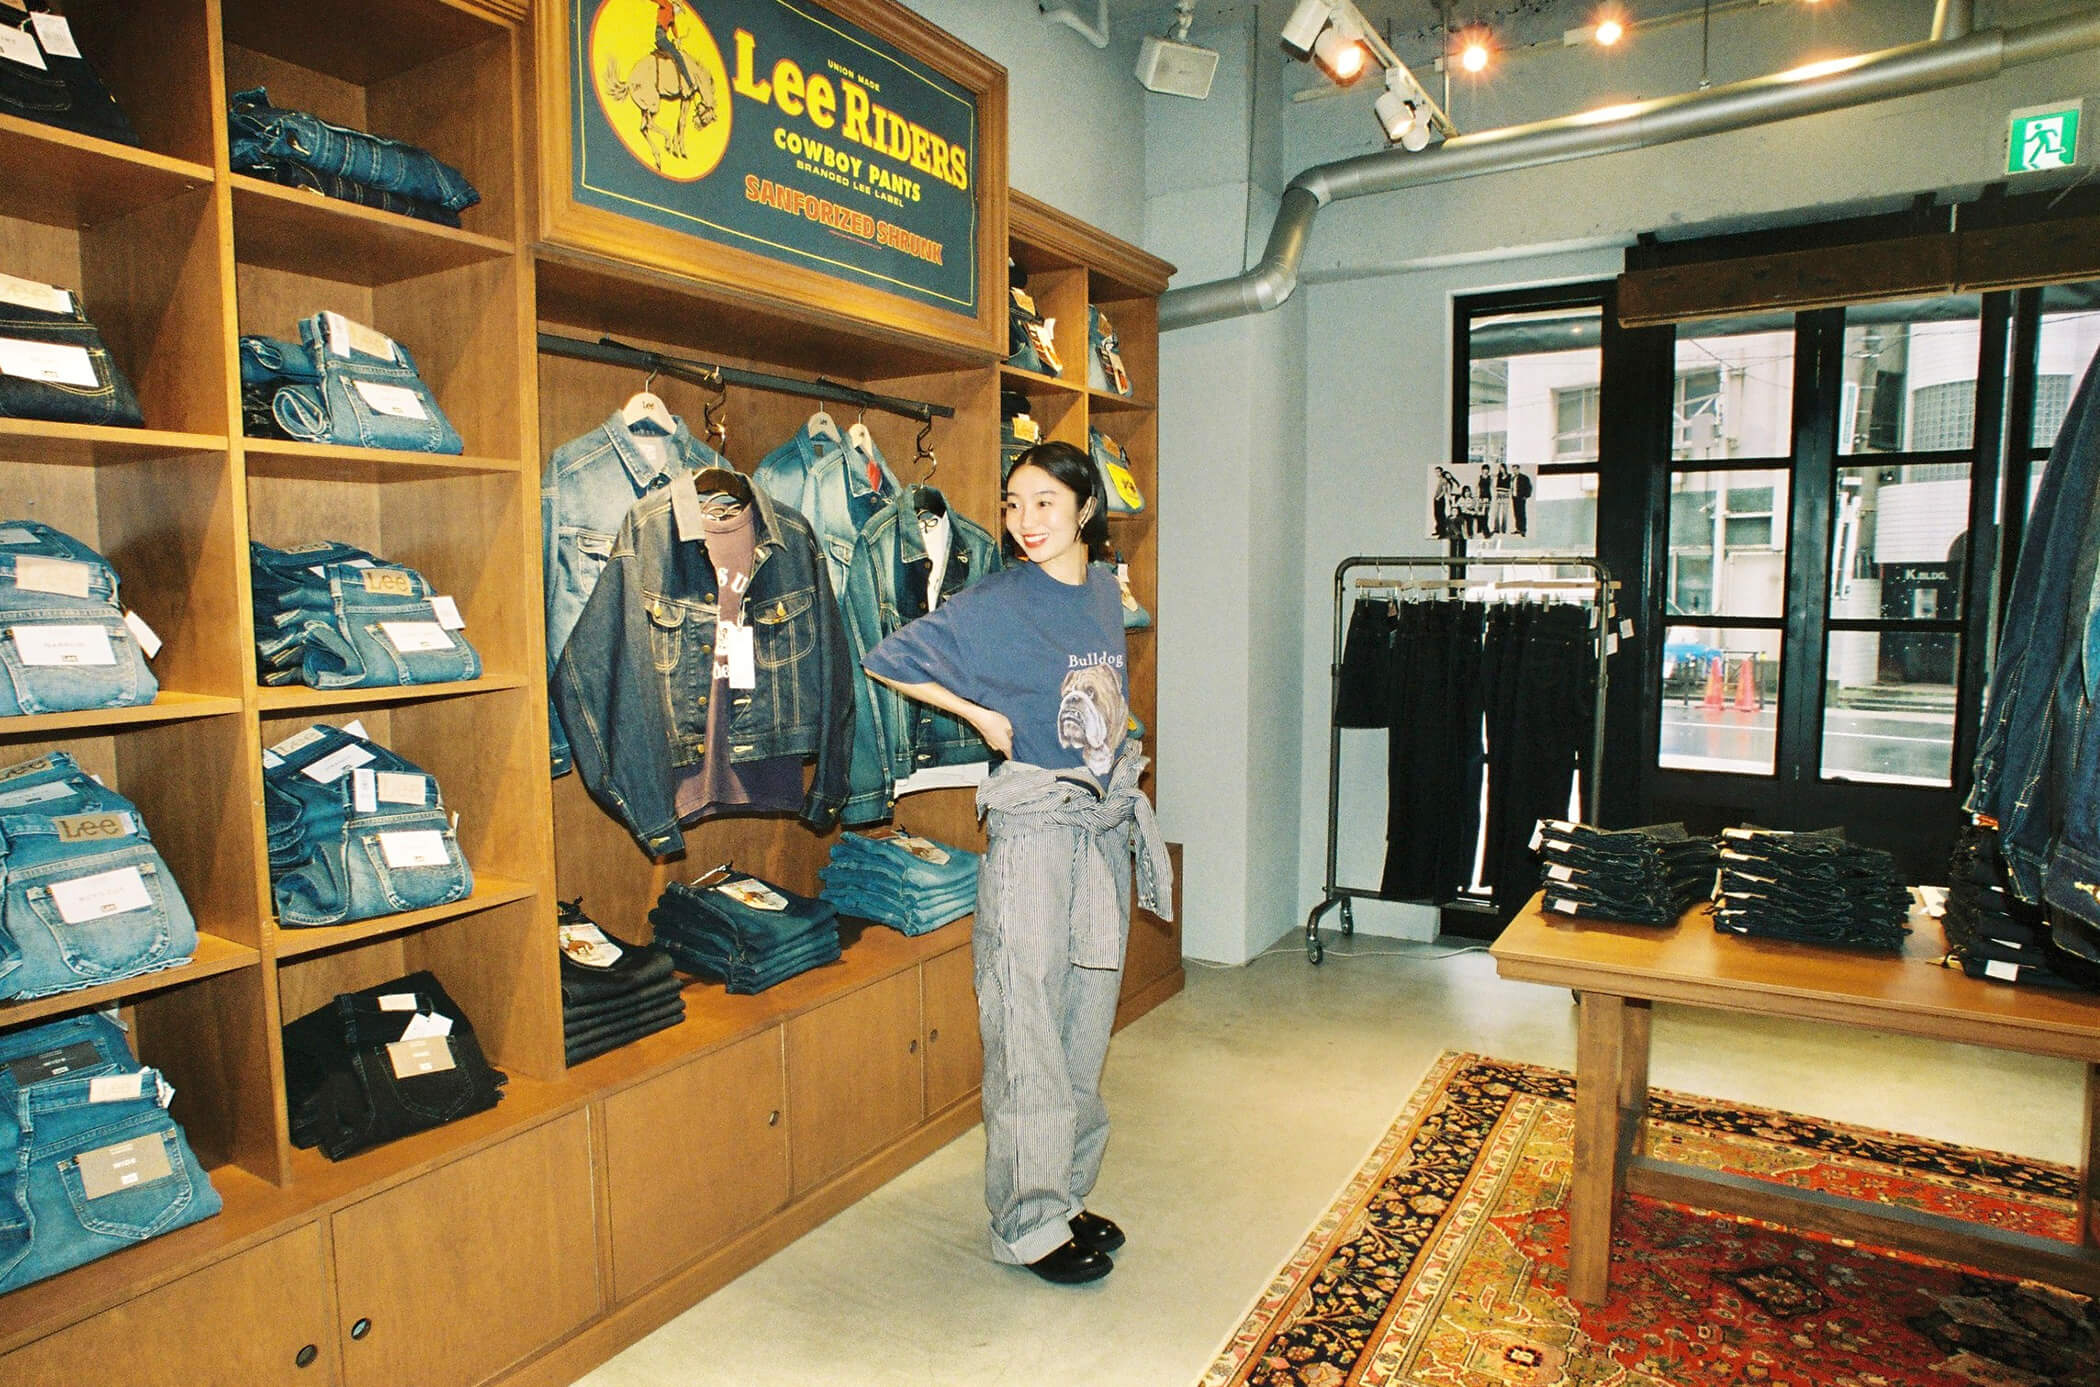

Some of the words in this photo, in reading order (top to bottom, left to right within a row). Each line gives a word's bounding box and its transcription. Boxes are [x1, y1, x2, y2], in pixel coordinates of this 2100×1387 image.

[827, 59, 854, 80] UNION
[857, 74, 881, 92] MADE
[732, 27, 836, 129] Lee
[840, 78, 968, 191] RIDERS
[773, 127, 862, 179] COWBOY
[868, 164, 921, 202] PANTS
[796, 160, 850, 186] BRANDED
[852, 181, 871, 195] LEE
[874, 189, 904, 208] LABEL
[744, 174, 876, 239] SANFORIZED
[876, 220, 944, 266] SHRUNK
[364, 571, 409, 592] Lee
[1068, 651, 1124, 669] Bulldog
[59, 818, 119, 839] Lee
